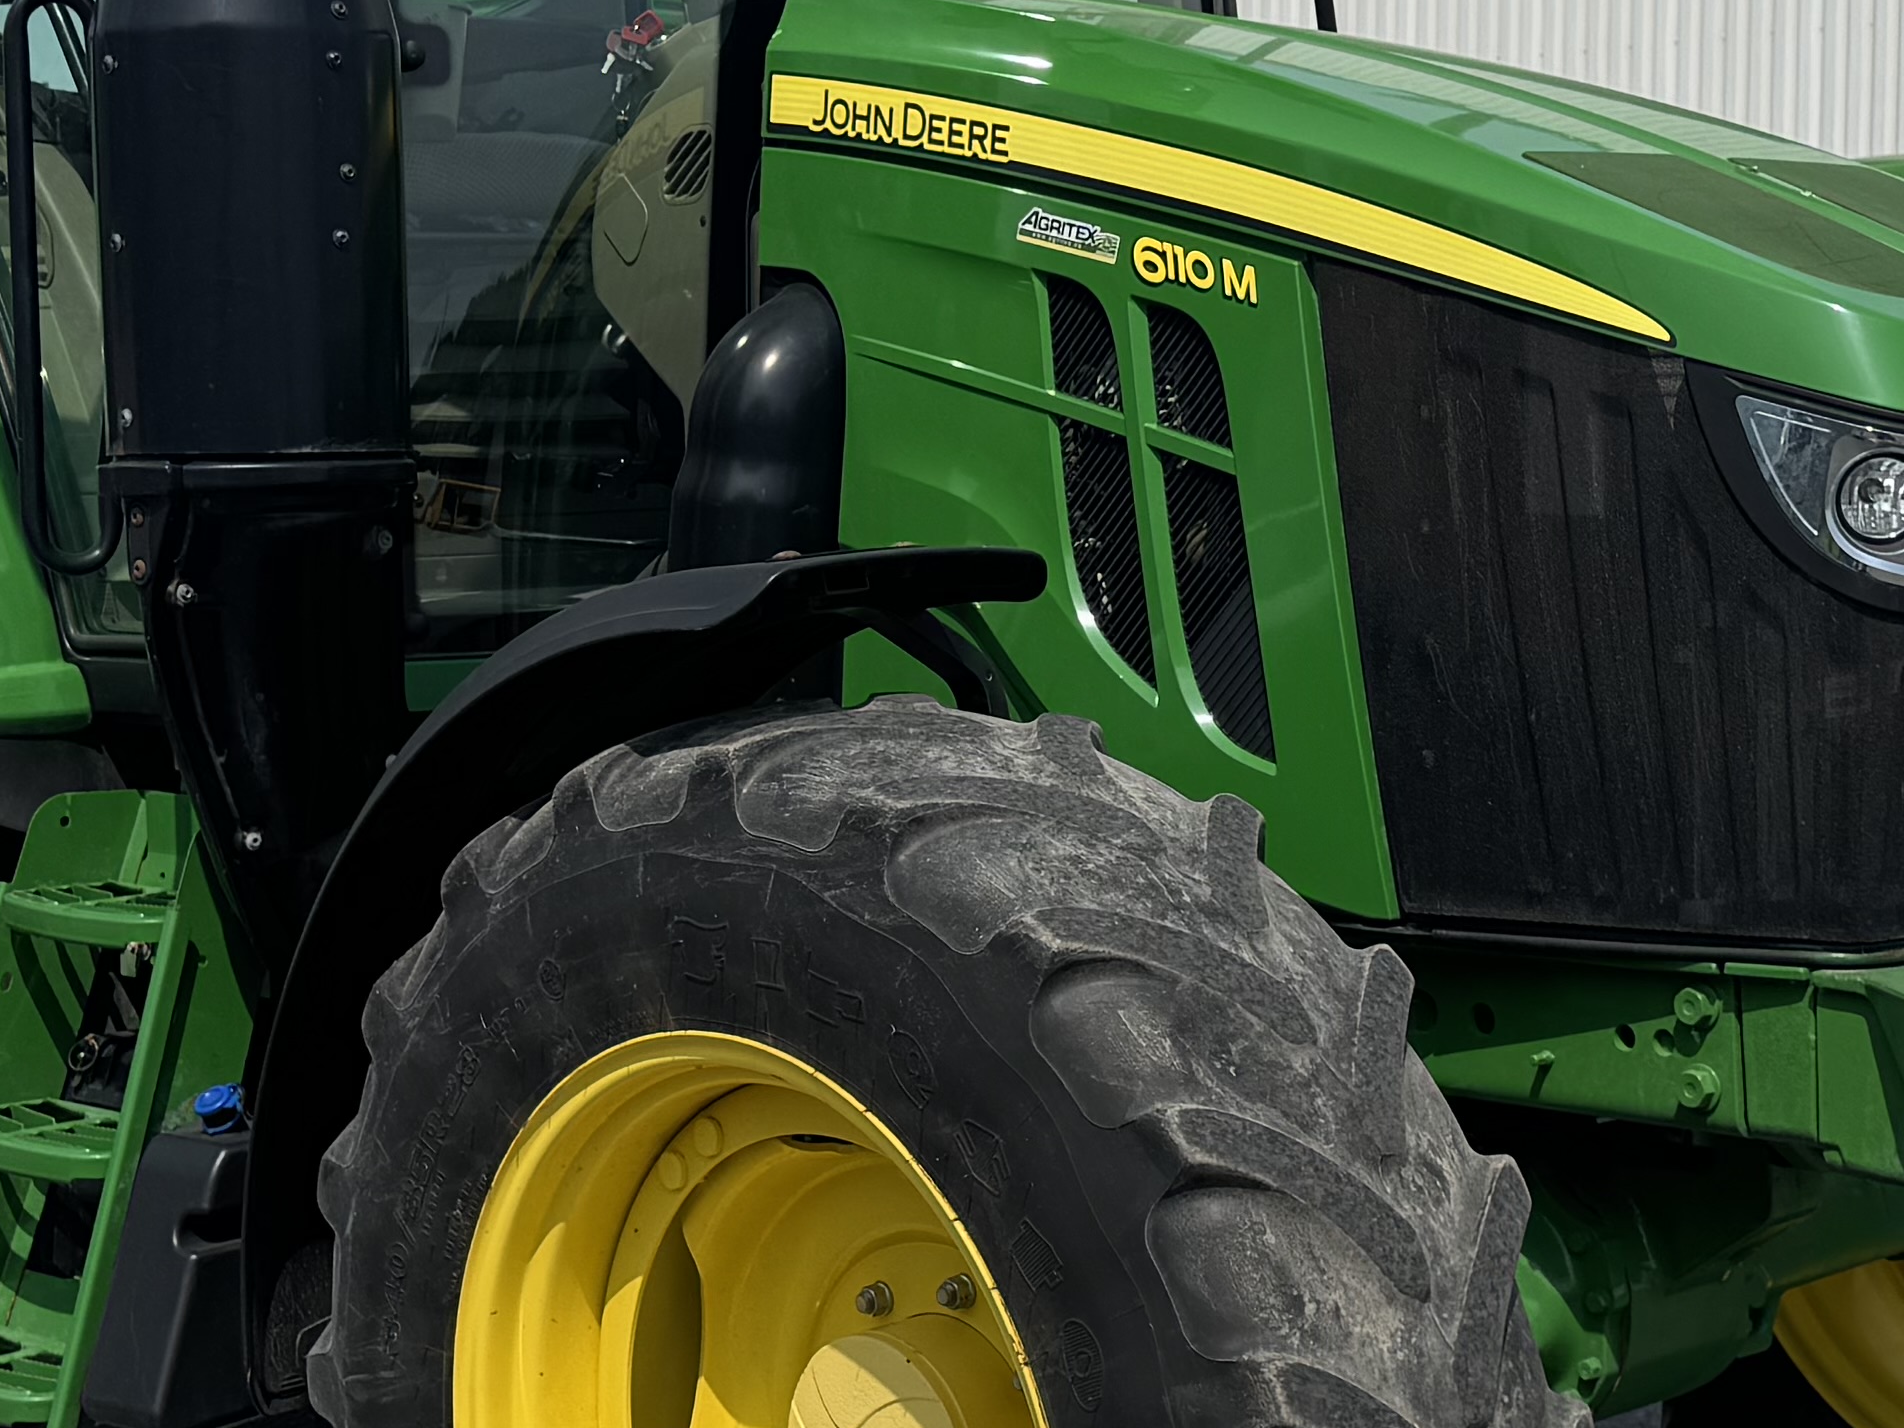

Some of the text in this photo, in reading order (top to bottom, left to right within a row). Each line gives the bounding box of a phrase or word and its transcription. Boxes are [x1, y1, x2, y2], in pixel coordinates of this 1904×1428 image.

[811, 87, 1011, 159] JOHN DEERE
[1021, 210, 1098, 244] AGRITEX
[1133, 236, 1215, 290] 6110
[1222, 257, 1258, 304] M
